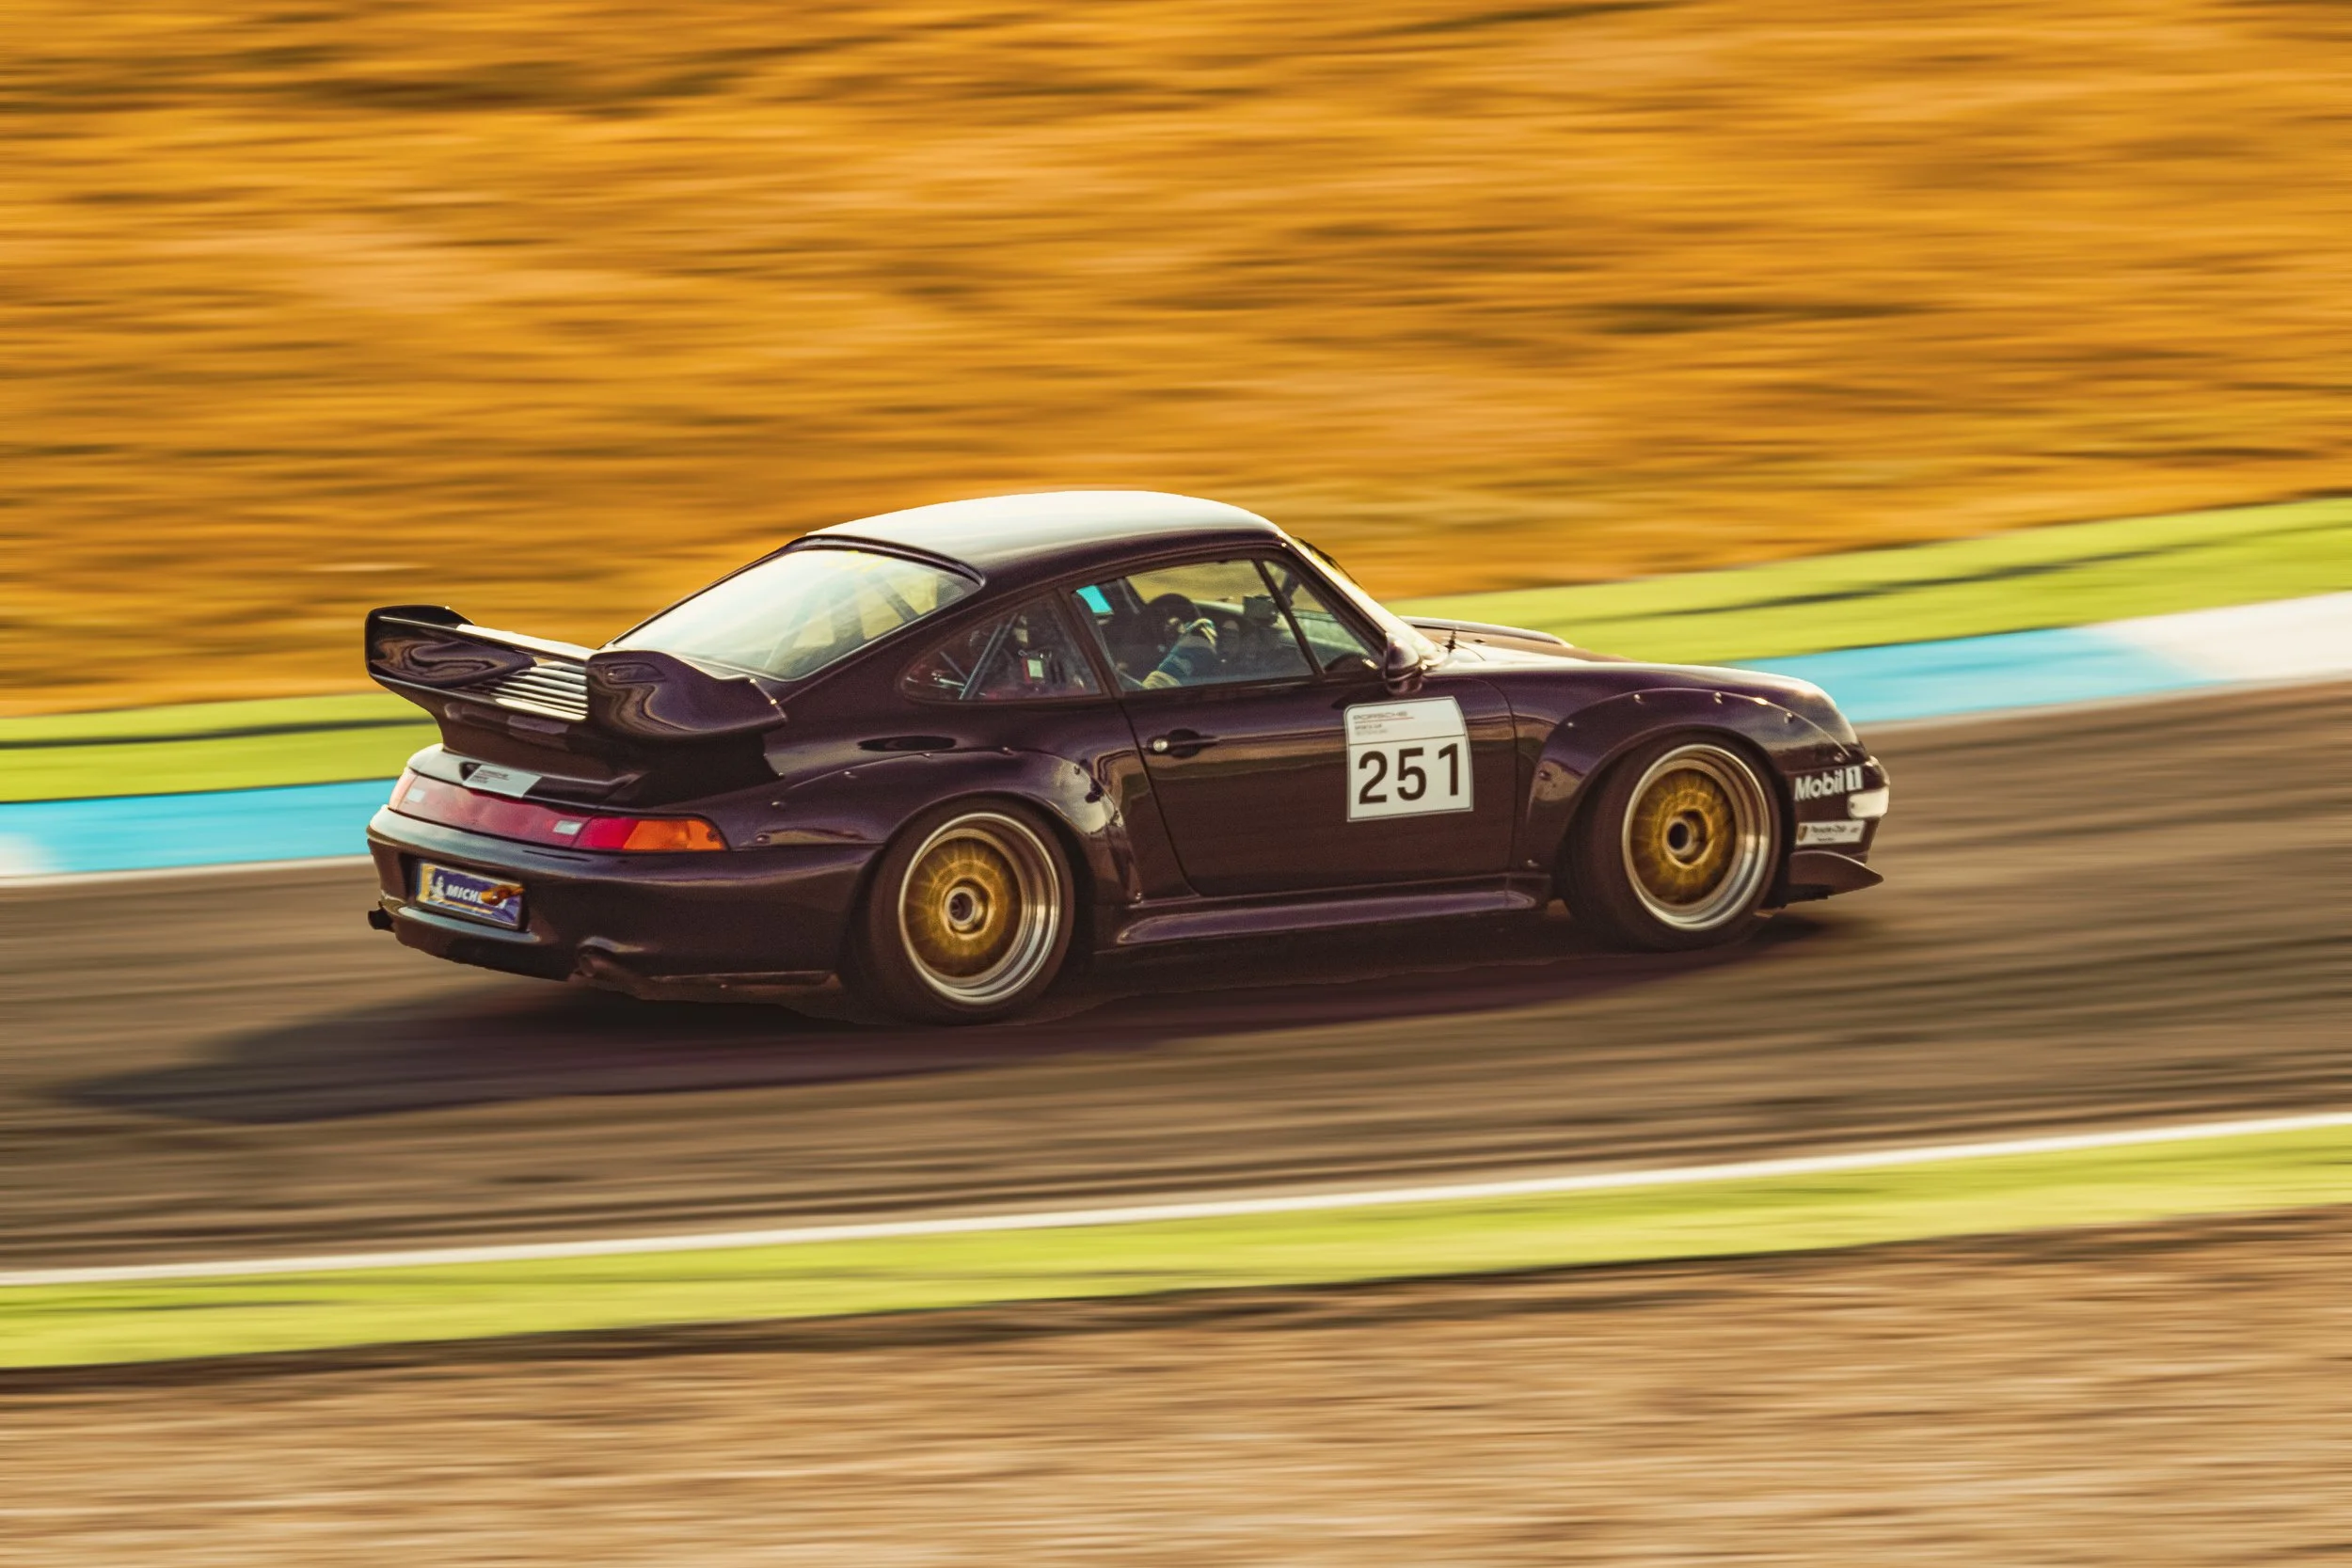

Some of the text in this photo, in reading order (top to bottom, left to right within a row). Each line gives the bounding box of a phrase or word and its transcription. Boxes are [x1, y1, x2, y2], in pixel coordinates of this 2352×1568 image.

[1359, 743, 1458, 804] 251
[1794, 769, 1844, 801] Mobil
[446, 884, 507, 909] MICH
